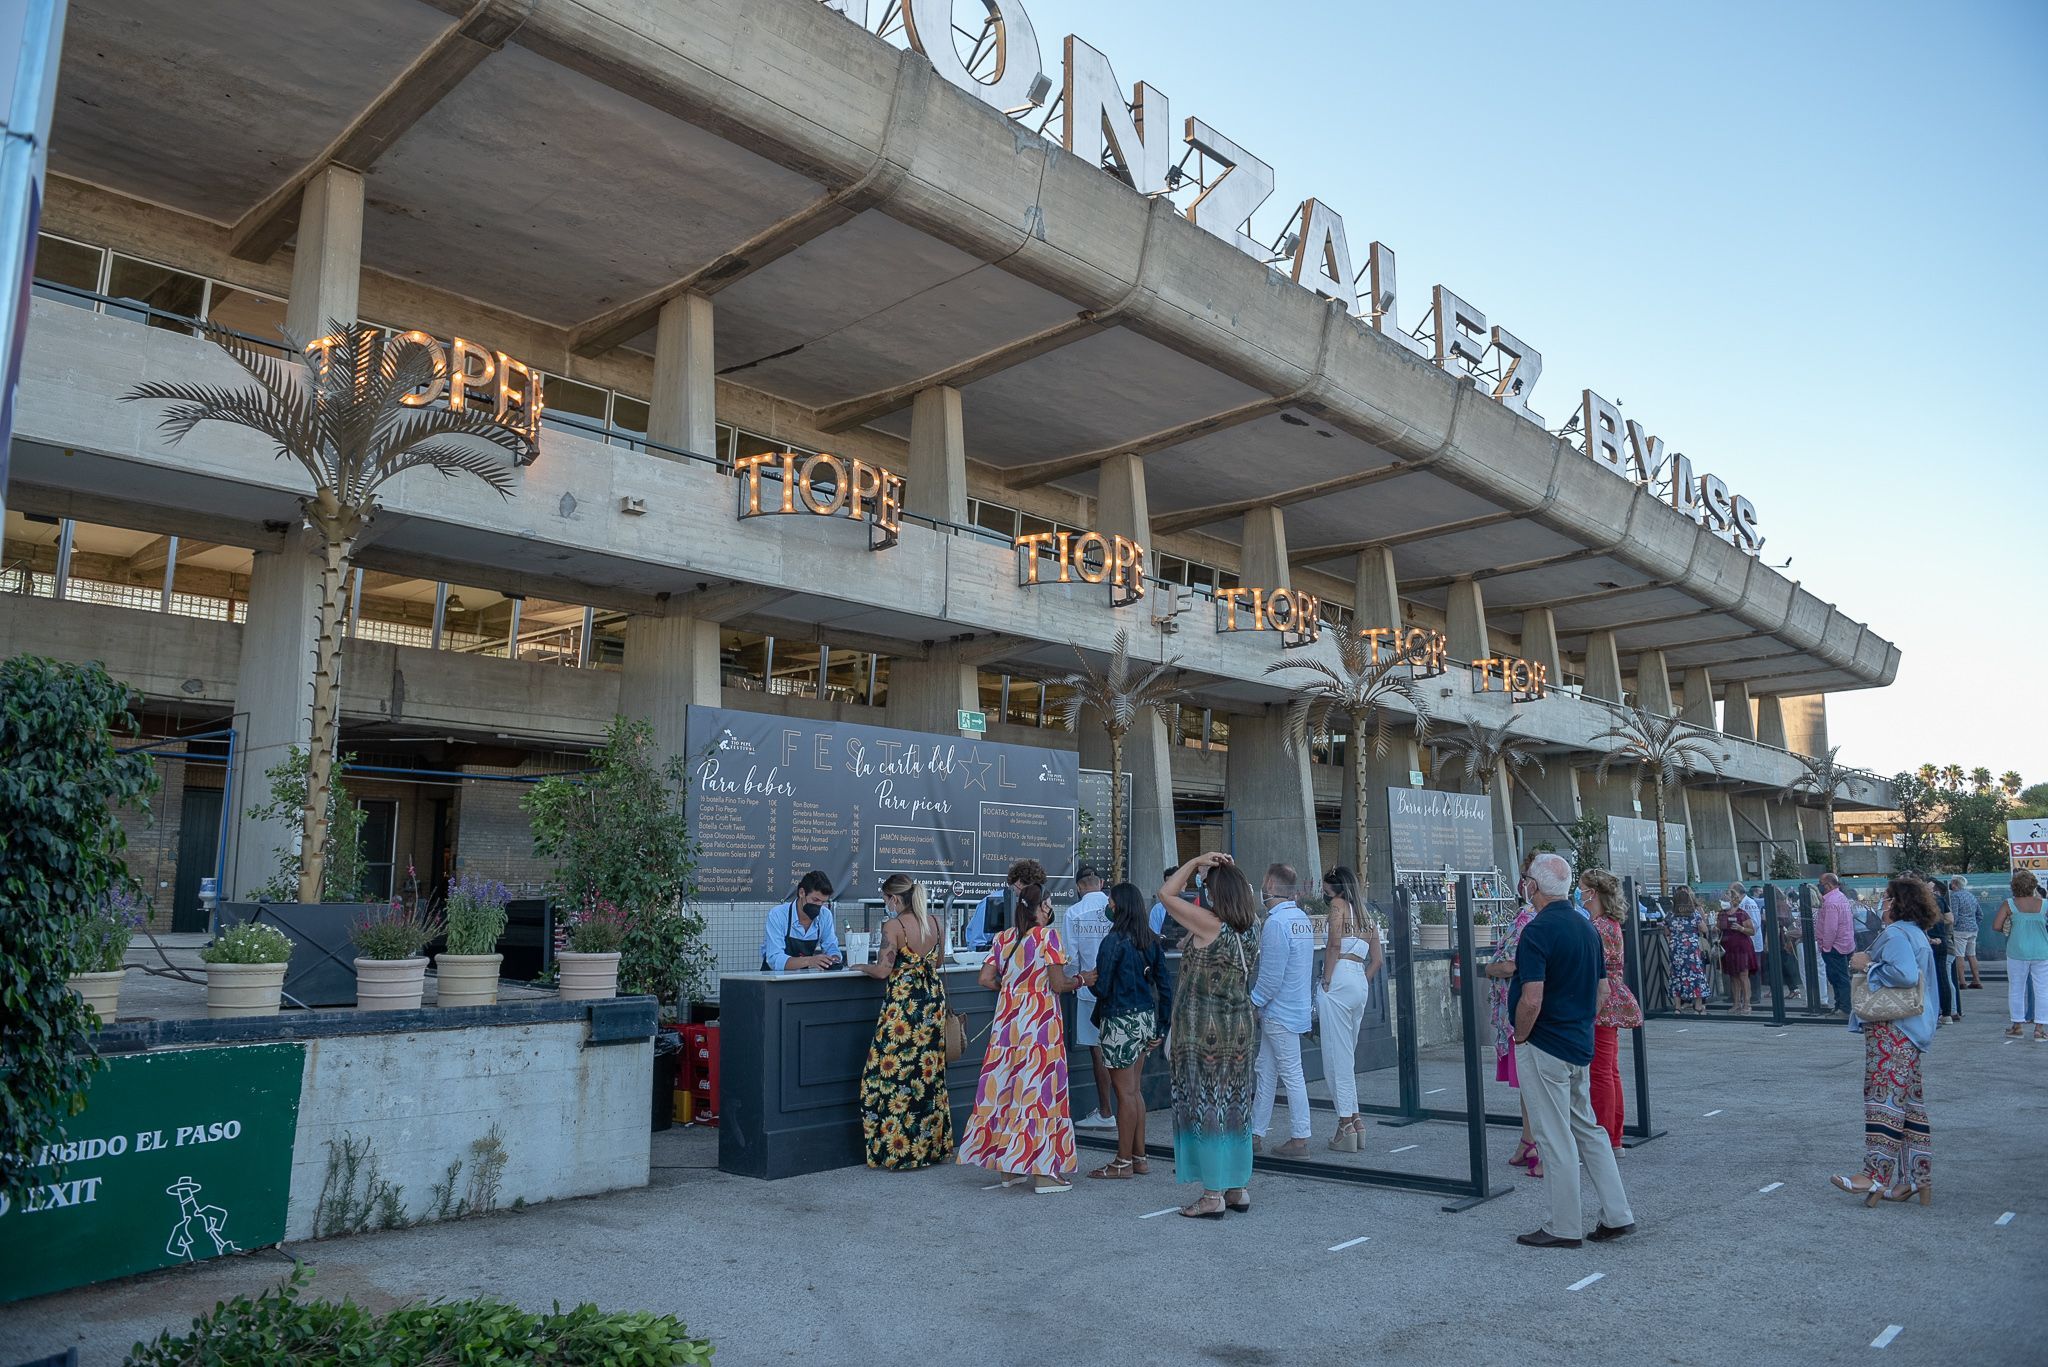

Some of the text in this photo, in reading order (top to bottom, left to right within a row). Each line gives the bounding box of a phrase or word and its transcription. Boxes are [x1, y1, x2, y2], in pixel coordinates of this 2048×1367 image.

[822, 0, 1760, 557] ONZALEZ BYASS
[696, 758, 796, 796] Para beber
[855, 744, 956, 778] la carta del
[699, 813, 714, 821] Copa
[700, 804, 714, 812] Copa
[874, 779, 952, 822] Para picar
[1397, 790, 1423, 815] Barra
[1454, 796, 1485, 820] Bebidas
[135, 1130, 168, 1152] EL
[175, 1120, 242, 1148] PASO
